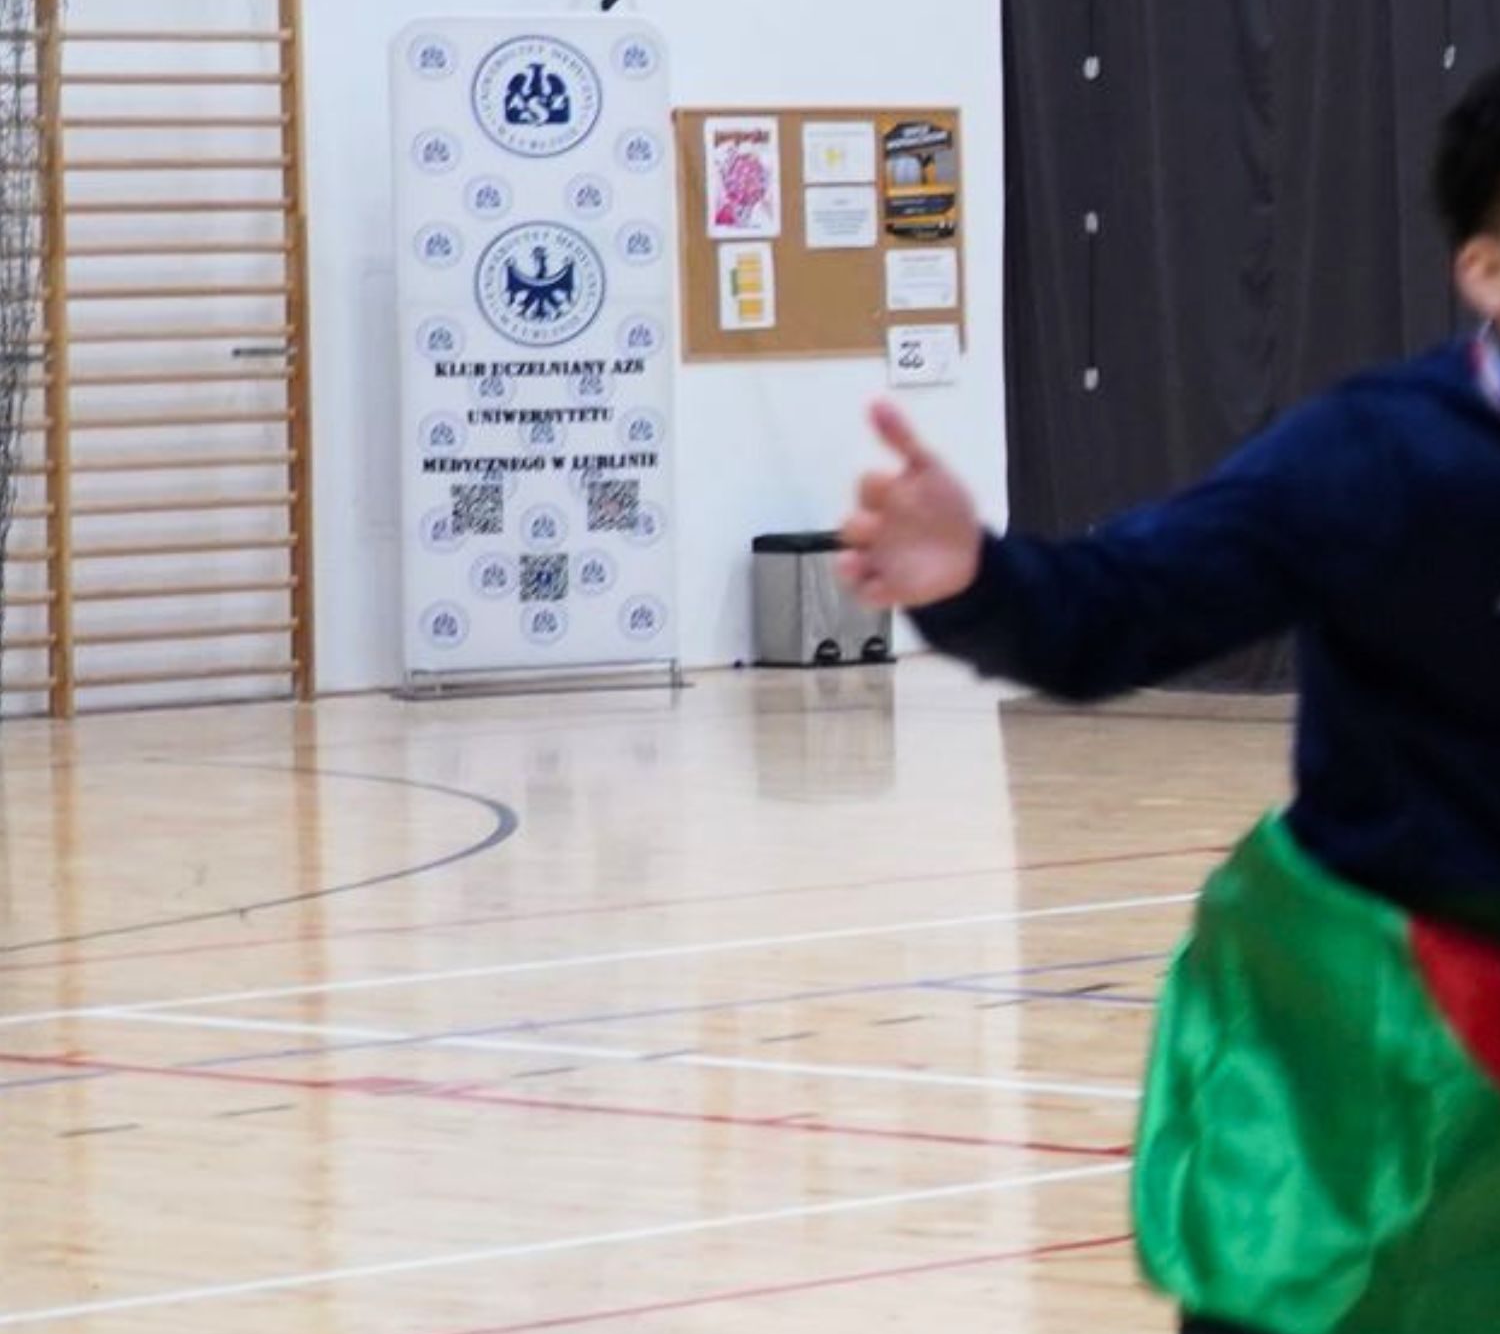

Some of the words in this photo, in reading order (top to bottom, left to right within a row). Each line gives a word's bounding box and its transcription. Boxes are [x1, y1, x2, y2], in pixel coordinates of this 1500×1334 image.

[434, 361, 486, 378] KLUB
[467, 408, 612, 424] UNIWERSYTETU
[422, 455, 546, 472] MEDYCZNEGO
[553, 456, 565, 469] W
[572, 453, 657, 470] LUBLINIE
